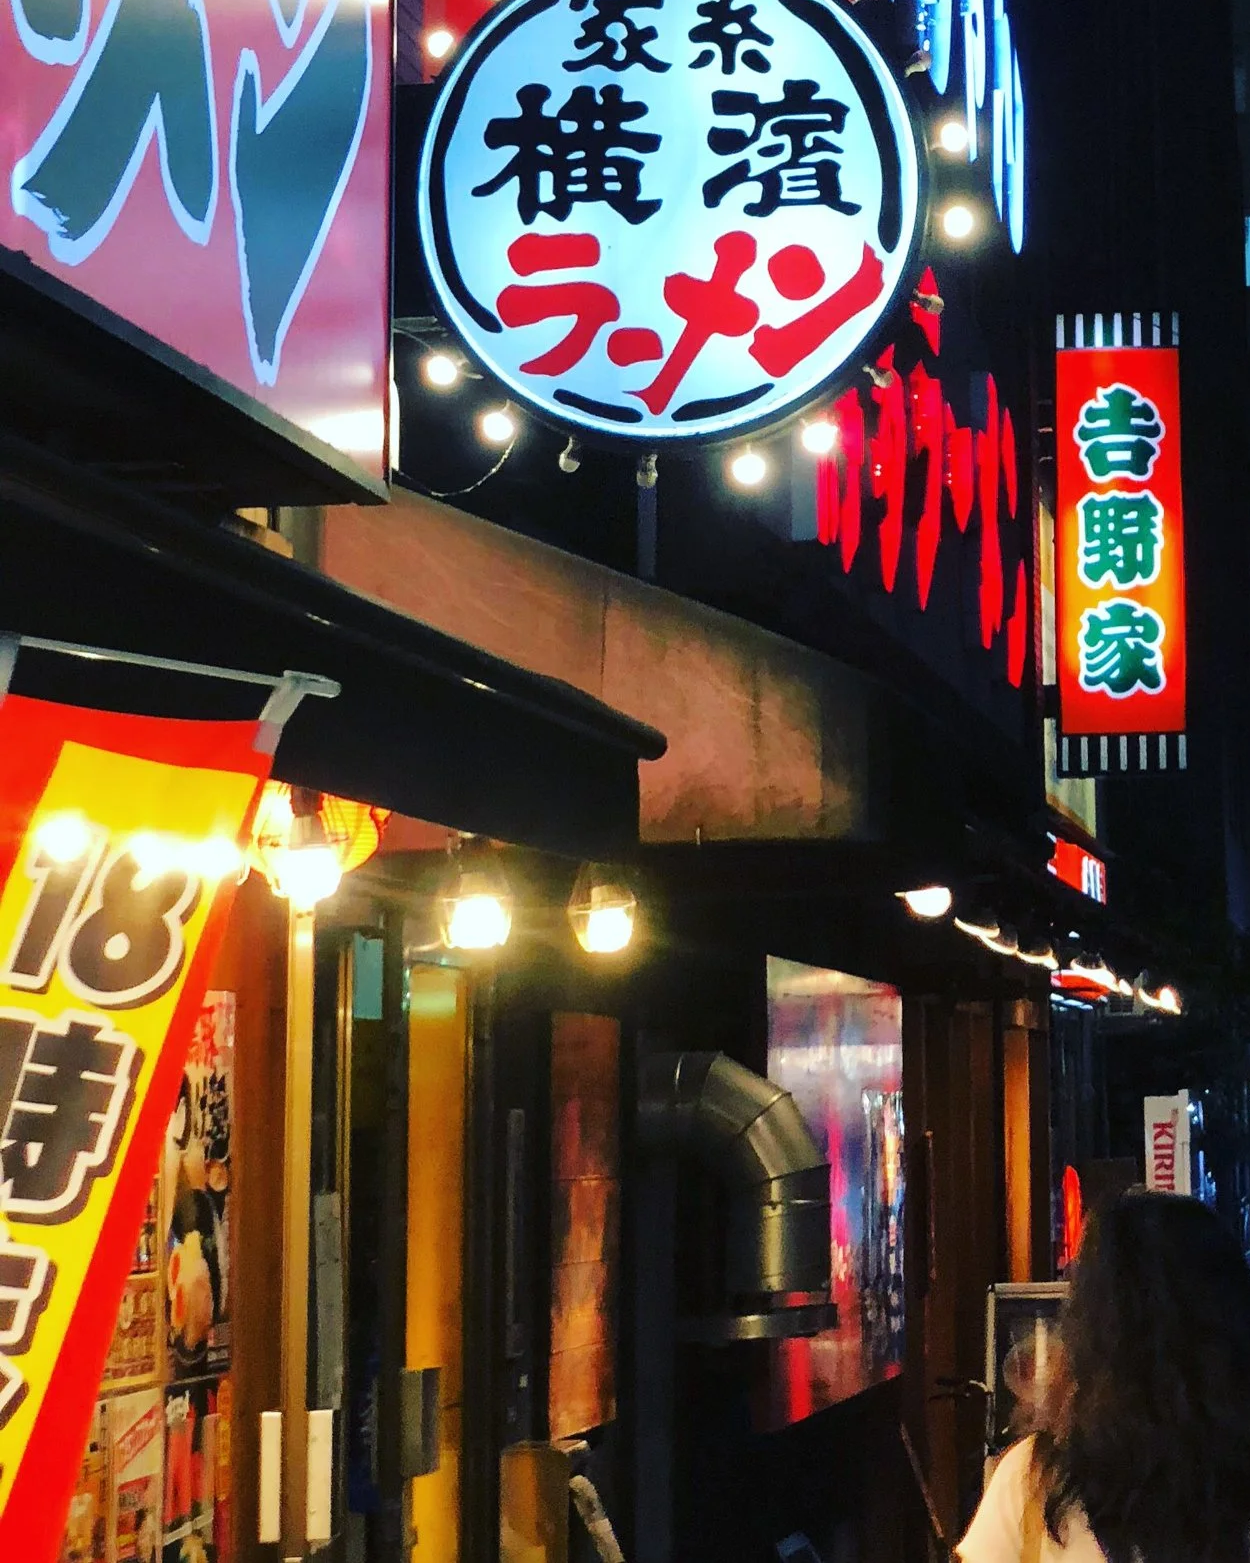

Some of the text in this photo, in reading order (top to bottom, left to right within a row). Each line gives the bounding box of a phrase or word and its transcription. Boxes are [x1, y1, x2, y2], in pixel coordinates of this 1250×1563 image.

[496, 230, 886, 415] ラーメン
[1073, 382, 1166, 699] 吉野家
